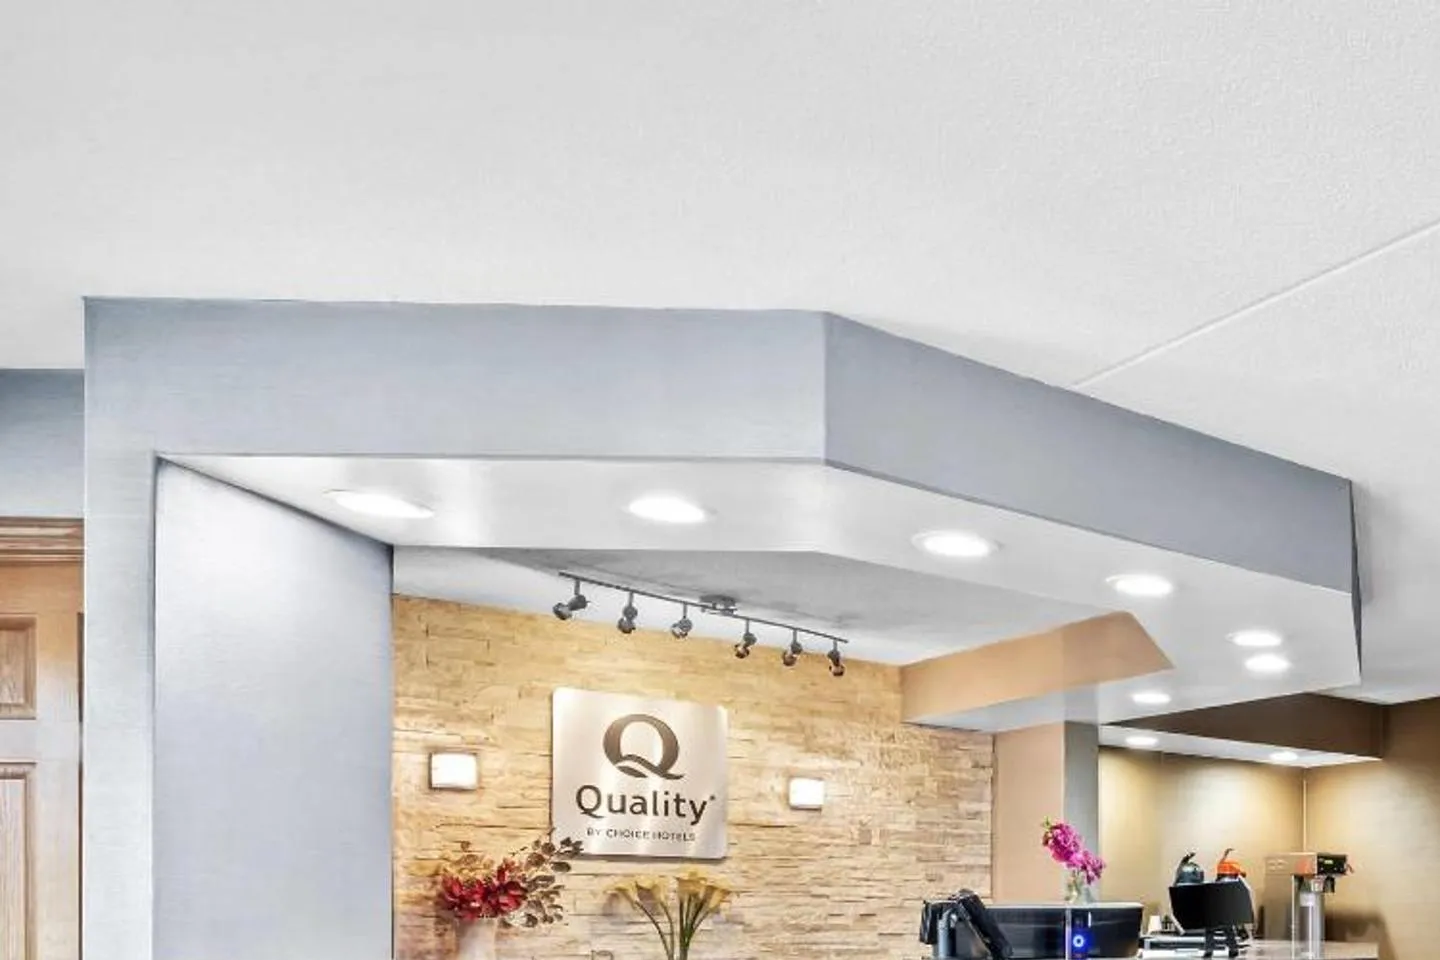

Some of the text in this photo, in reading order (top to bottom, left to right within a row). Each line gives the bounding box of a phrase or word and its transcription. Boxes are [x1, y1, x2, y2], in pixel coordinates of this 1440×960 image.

[575, 785, 708, 826] Quality
[587, 828, 696, 842] BY CHOICE HOTELS
